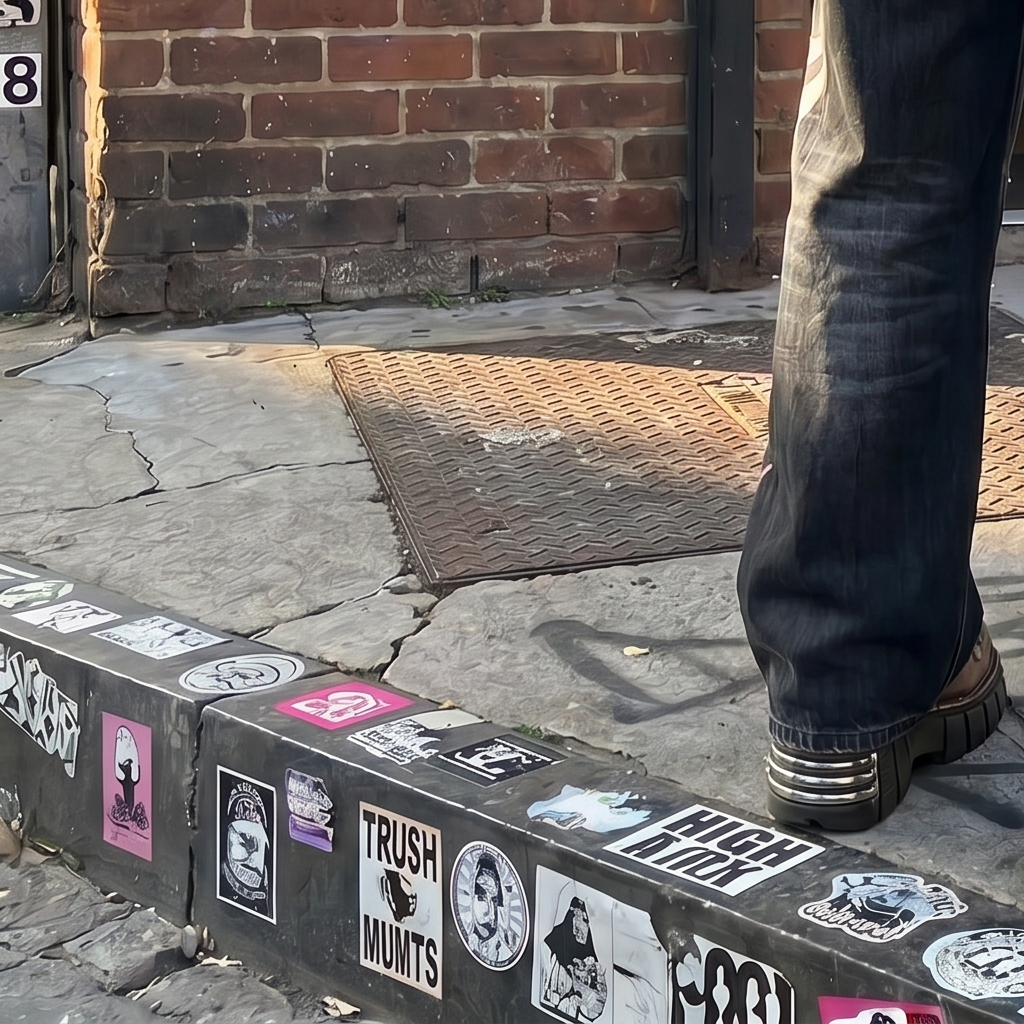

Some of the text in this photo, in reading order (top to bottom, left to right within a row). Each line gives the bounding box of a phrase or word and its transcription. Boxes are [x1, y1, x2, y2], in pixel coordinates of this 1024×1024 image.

[3, 56, 38, 104] 8
[362, 808, 437, 883] TRUSH
[660, 809, 813, 868] HIGH
[363, 914, 439, 989] MUMTS
